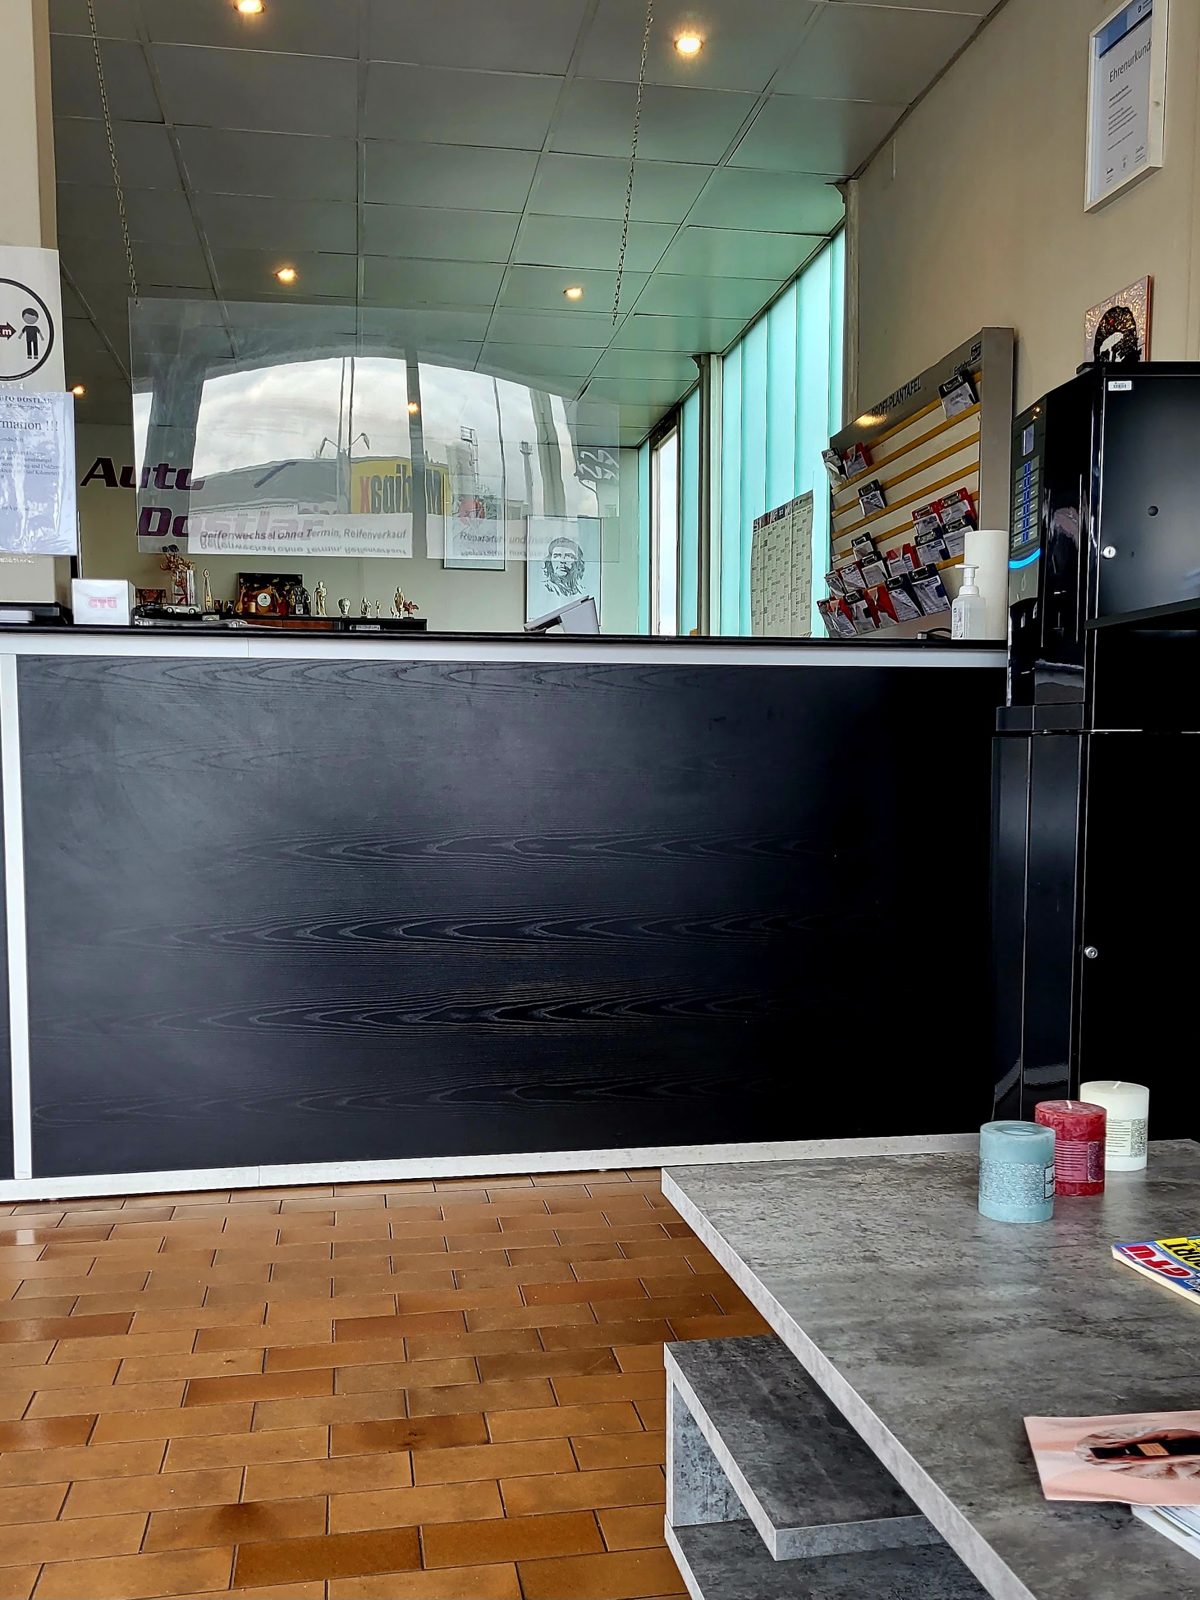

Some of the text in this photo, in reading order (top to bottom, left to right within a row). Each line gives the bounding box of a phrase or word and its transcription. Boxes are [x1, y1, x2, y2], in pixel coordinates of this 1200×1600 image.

[1108, 38, 1152, 84] Ehrenurkund
[80, 457, 205, 491] Auto
[136, 506, 325, 541] Dostlar
